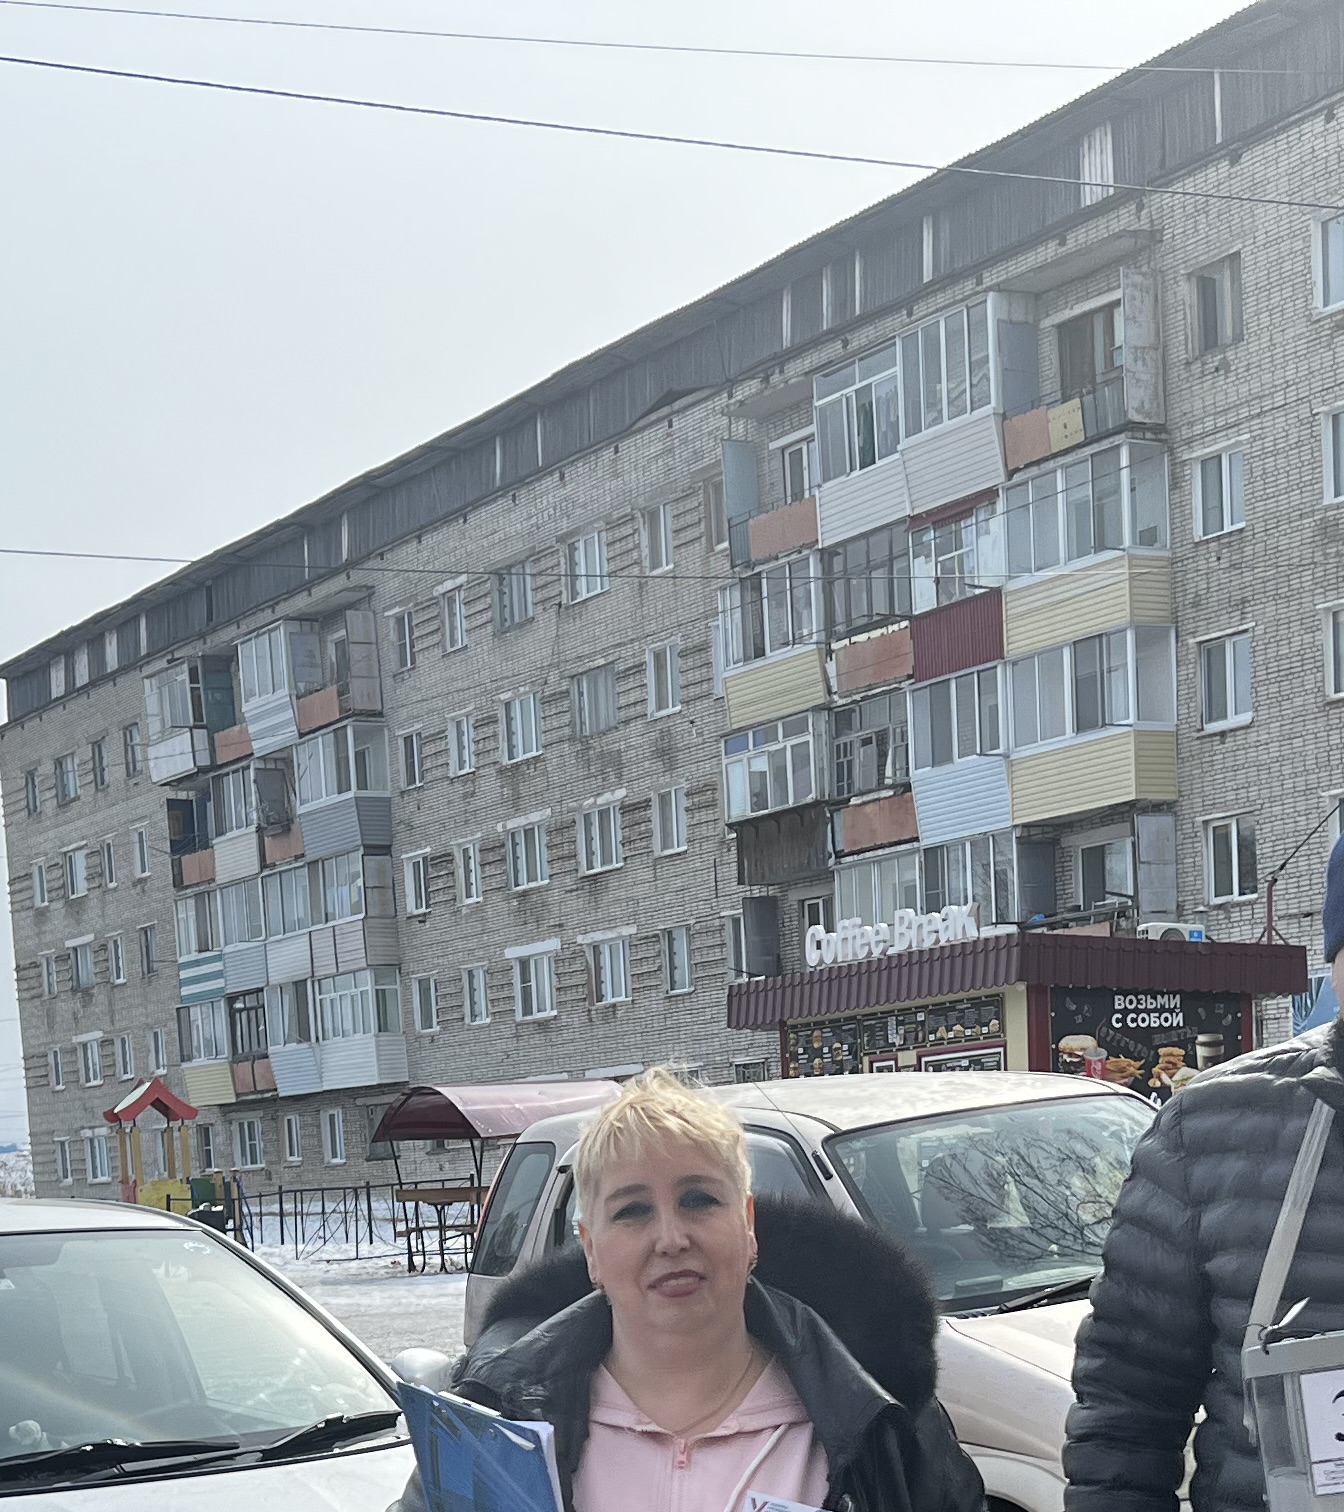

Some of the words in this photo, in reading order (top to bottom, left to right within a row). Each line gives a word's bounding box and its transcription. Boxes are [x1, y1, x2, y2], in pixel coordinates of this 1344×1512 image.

[806, 916, 890, 967] Coffee
[894, 902, 980, 951] Break
[1113, 993, 1181, 1010] ВОЗЬМИ
[1111, 1012, 1123, 1029] С
[1126, 1009, 1184, 1029] СОБОЙ
